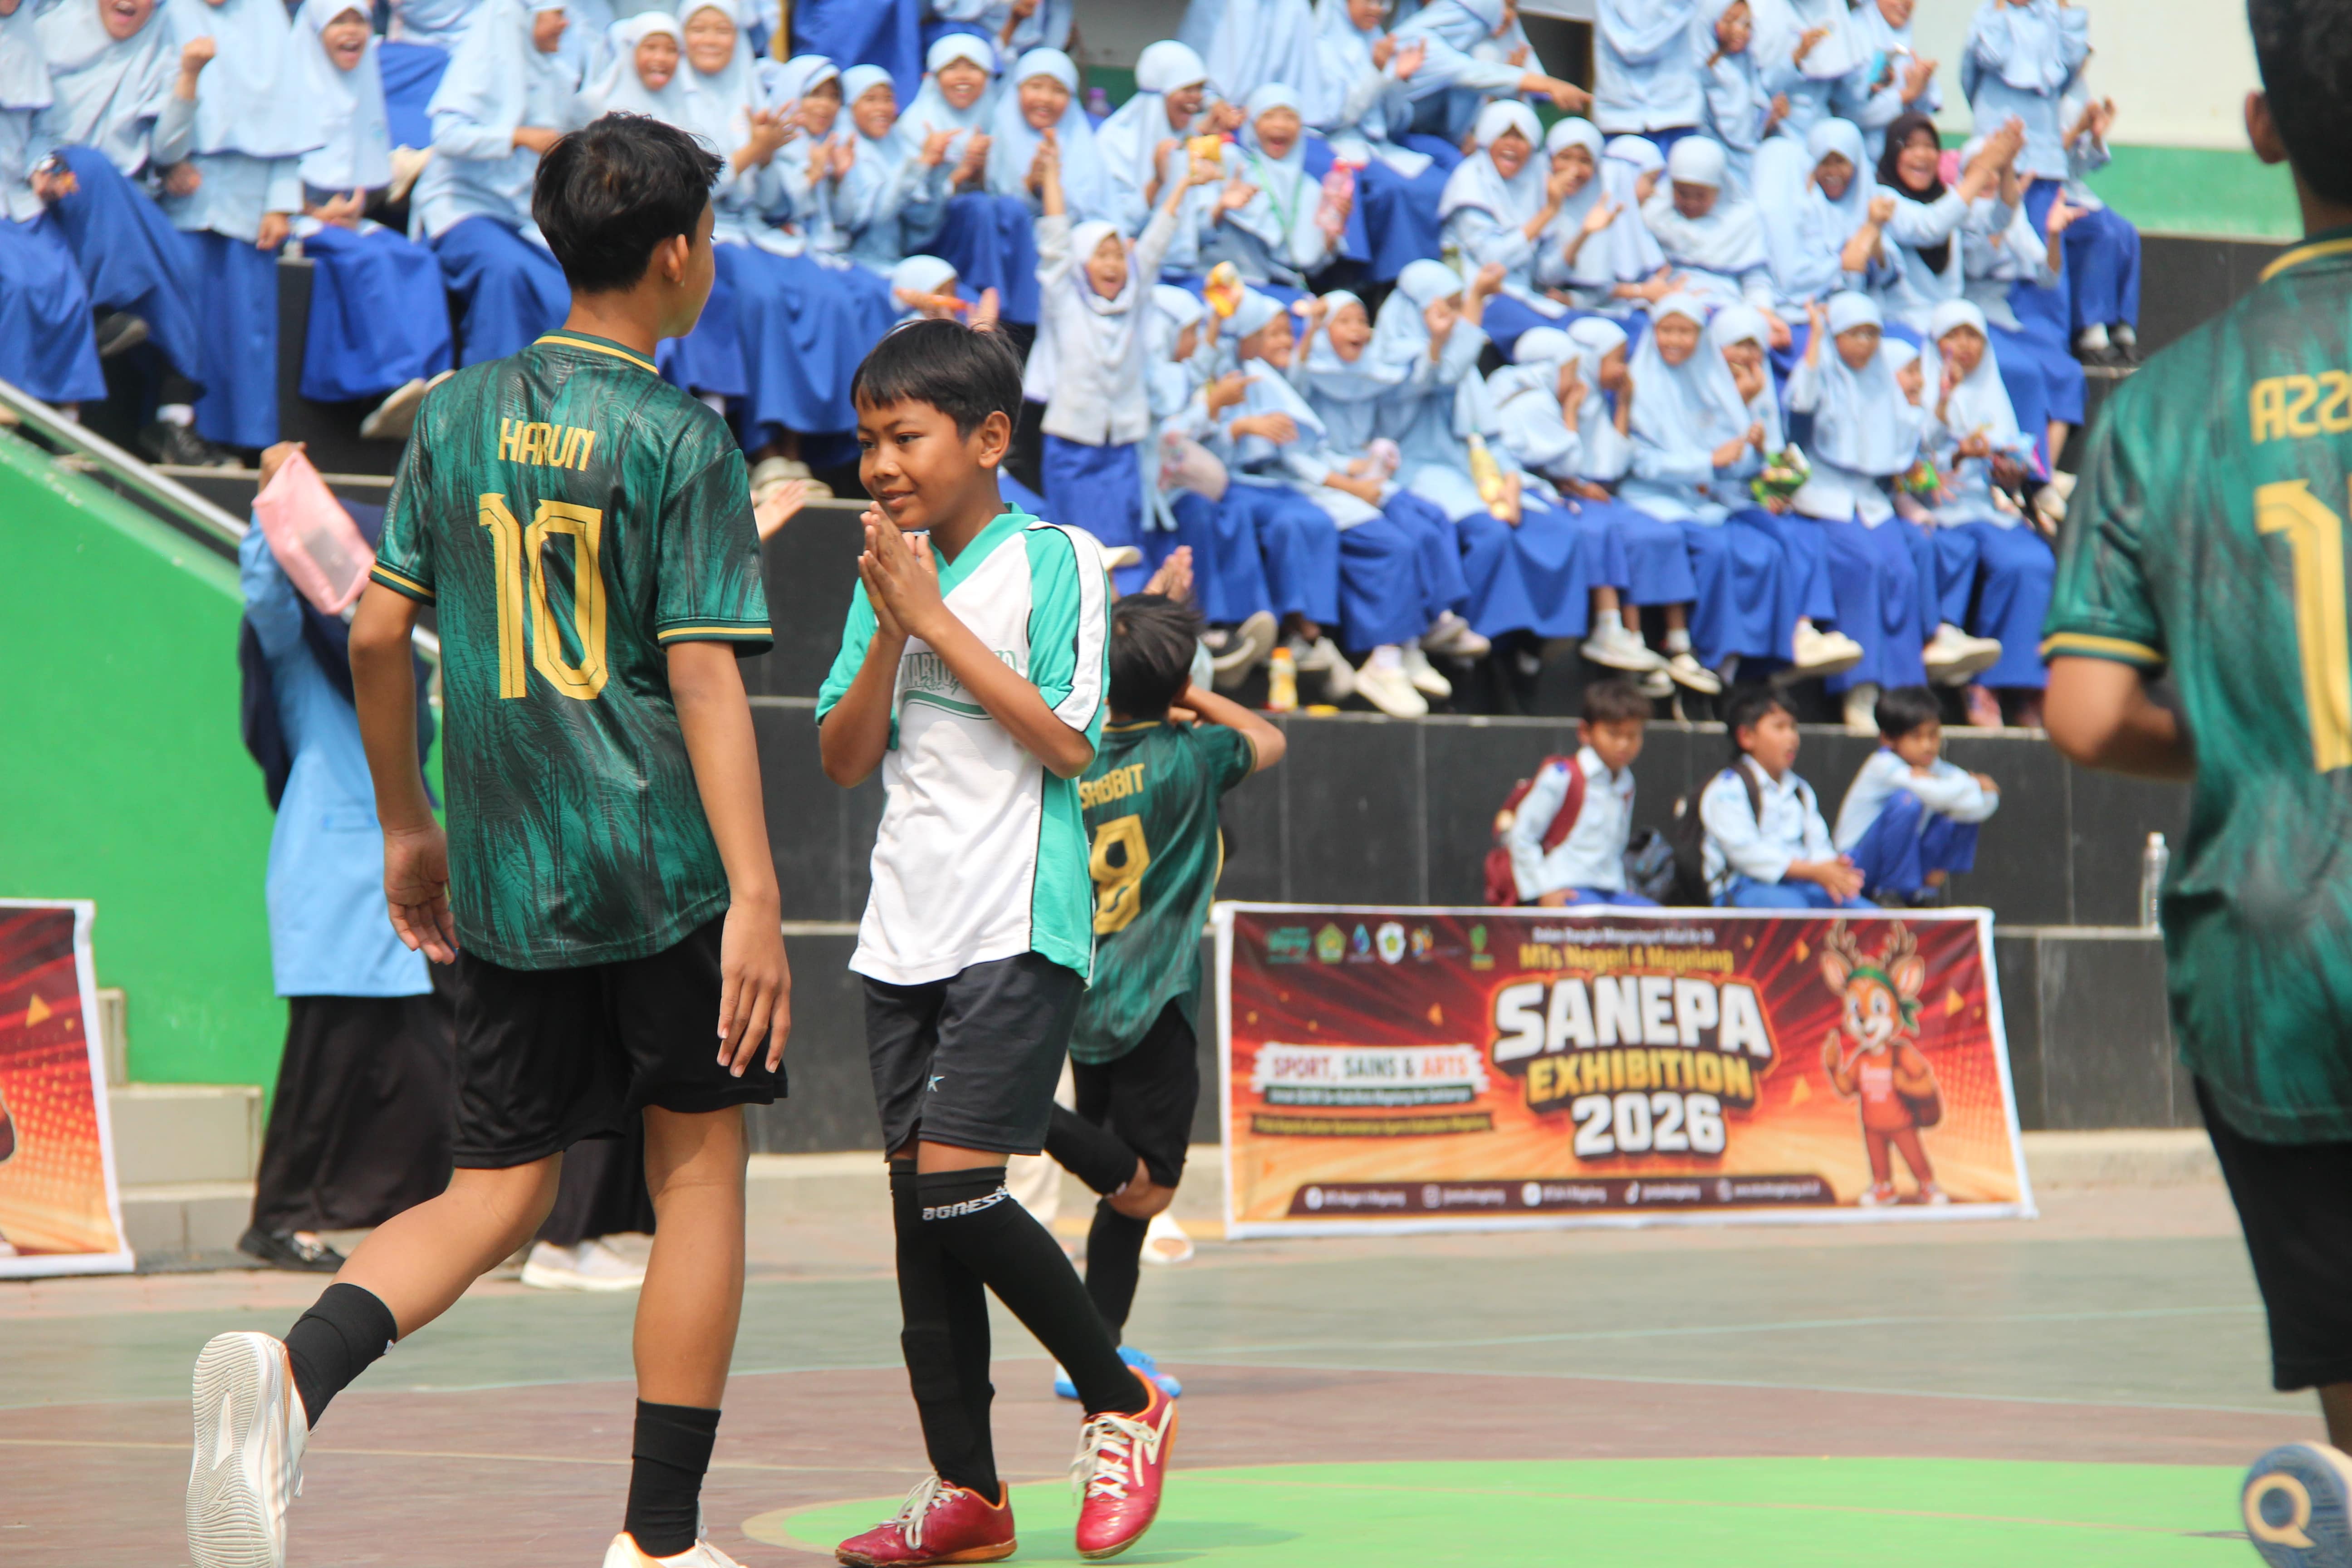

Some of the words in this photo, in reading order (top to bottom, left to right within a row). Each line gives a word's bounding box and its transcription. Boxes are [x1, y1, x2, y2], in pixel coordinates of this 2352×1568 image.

[2249, 369, 2352, 446] AZZ
[498, 417, 596, 471] HARUN
[479, 492, 608, 700] 10
[2254, 472, 2352, 774] 1
[1089, 814, 1151, 935] 9
[1519, 943, 1562, 970] MTs
[1564, 943, 1629, 975] Negeri
[1646, 944, 1734, 975] Magelang
[1495, 976, 1772, 1062] SANEPA
[1274, 1055, 1338, 1083] SPORT,
[1344, 1055, 1396, 1079] SAINS
[1421, 1054, 1469, 1078] ARTS
[1527, 1051, 1753, 1104] EXHIBITION
[1571, 1093, 1725, 1156] 2026
